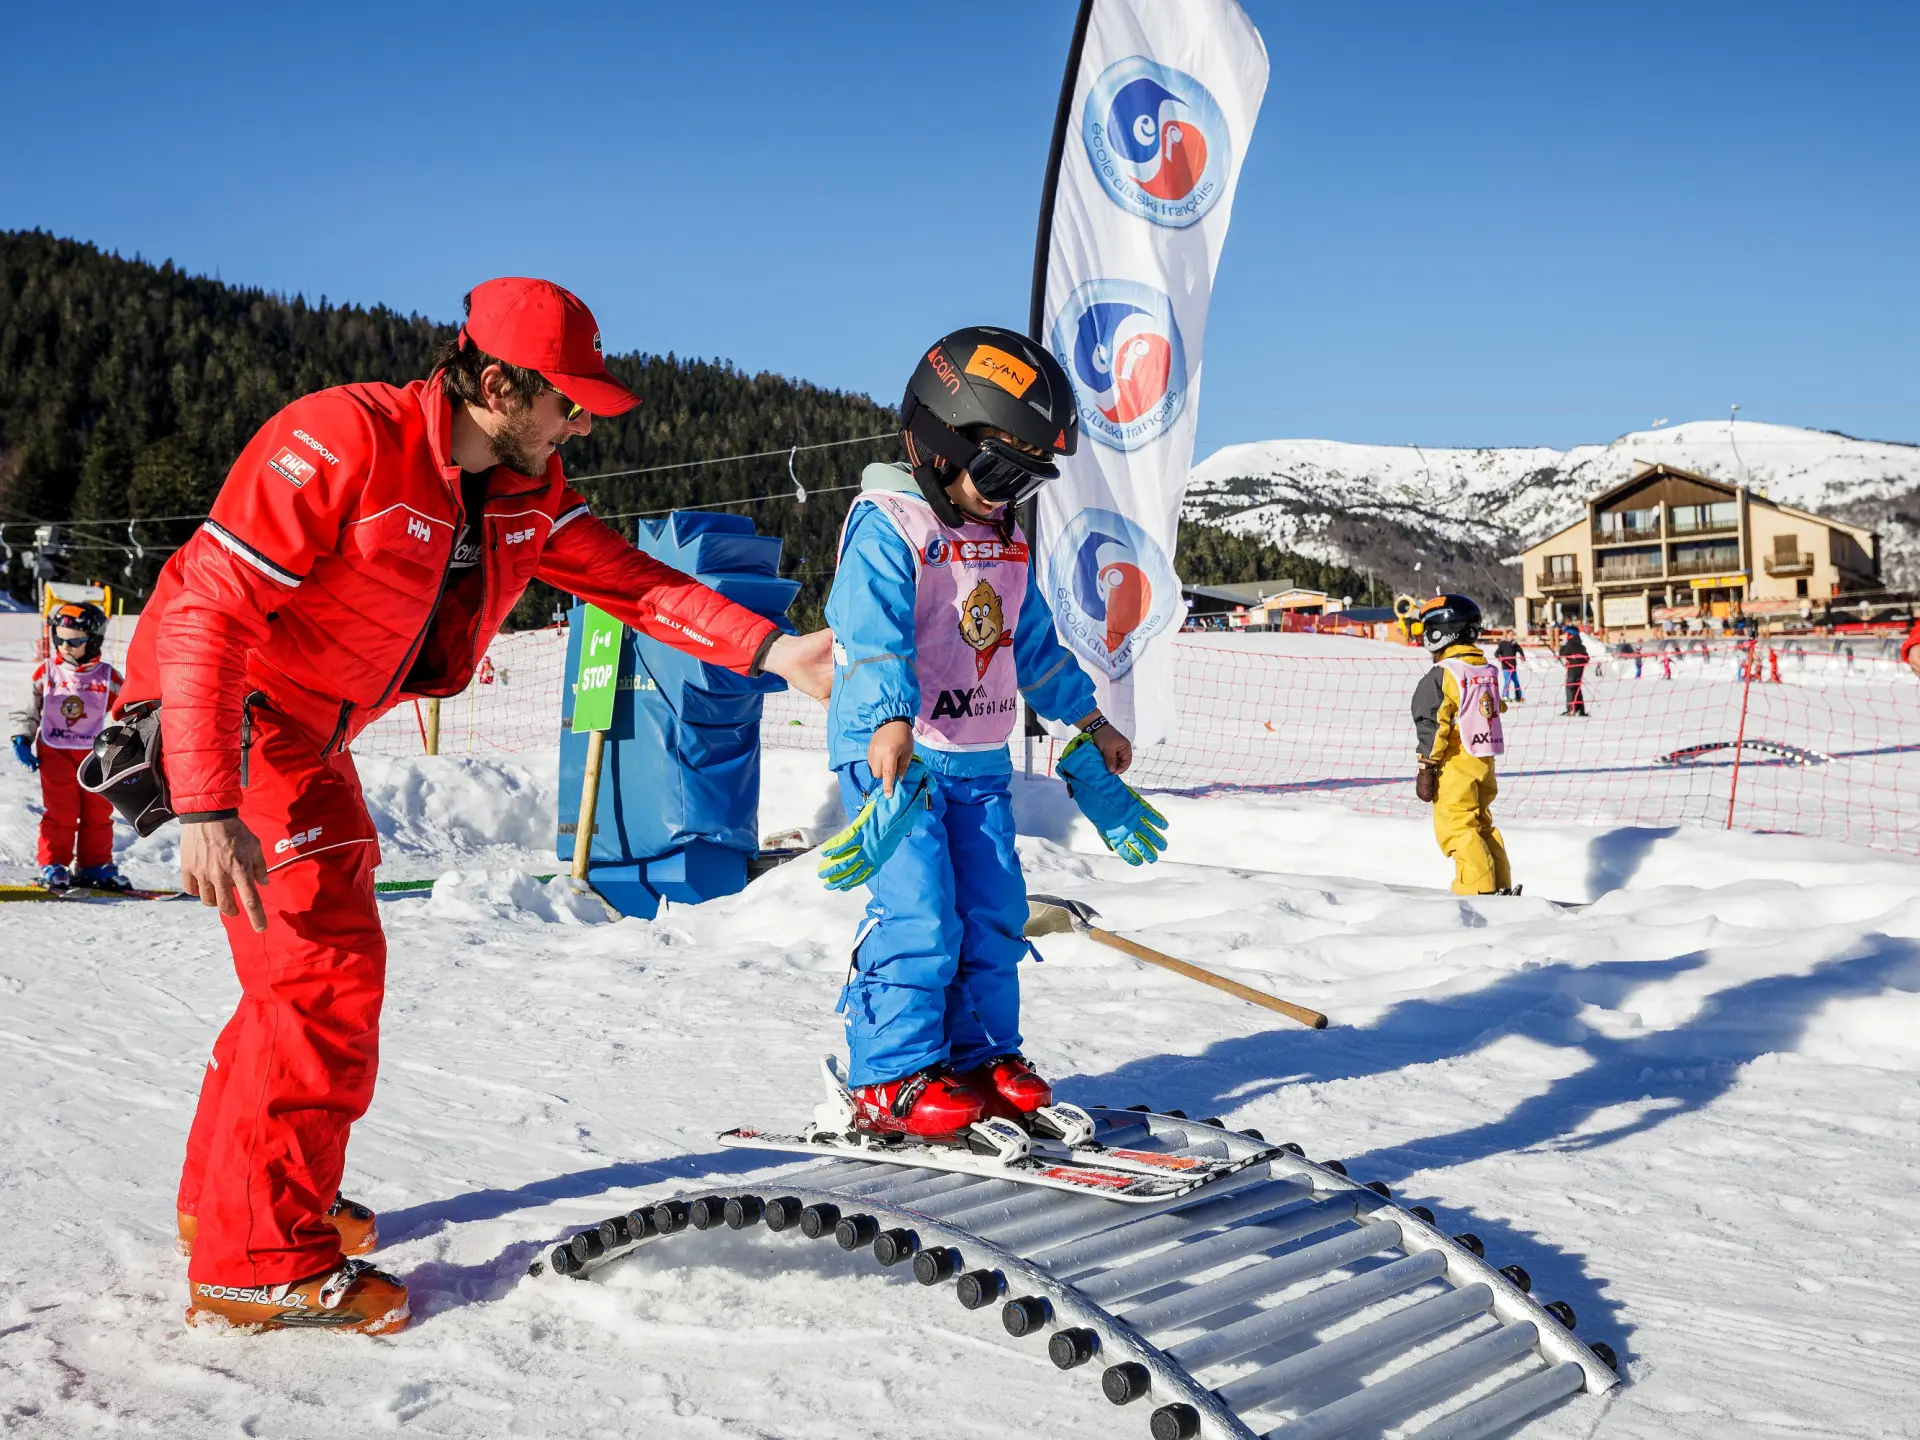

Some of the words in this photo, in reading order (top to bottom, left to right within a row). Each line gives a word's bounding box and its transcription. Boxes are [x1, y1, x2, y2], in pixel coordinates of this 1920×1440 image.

[1091, 121, 1114, 178] école
[1113, 177, 1134, 199] du
[1135, 193, 1158, 214] ski
[1161, 180, 1214, 218] français
[931, 354, 961, 396] cairn
[1081, 404, 1104, 429] du
[1104, 421, 1124, 441] ski
[1126, 389, 1179, 441] français
[280, 453, 307, 476] RMC
[292, 429, 340, 466] EUROSPORT
[407, 516, 431, 543] HH
[655, 613, 682, 630] HELLY
[681, 626, 714, 648] HANSEN
[1057, 586, 1088, 640] école
[581, 664, 613, 692] STOP
[930, 685, 974, 721] AX
[975, 702, 985, 717] 05
[986, 700, 996, 715] 61
[1471, 732, 1490, 746] AX
[196, 1283, 309, 1310] ROSSIGOL
